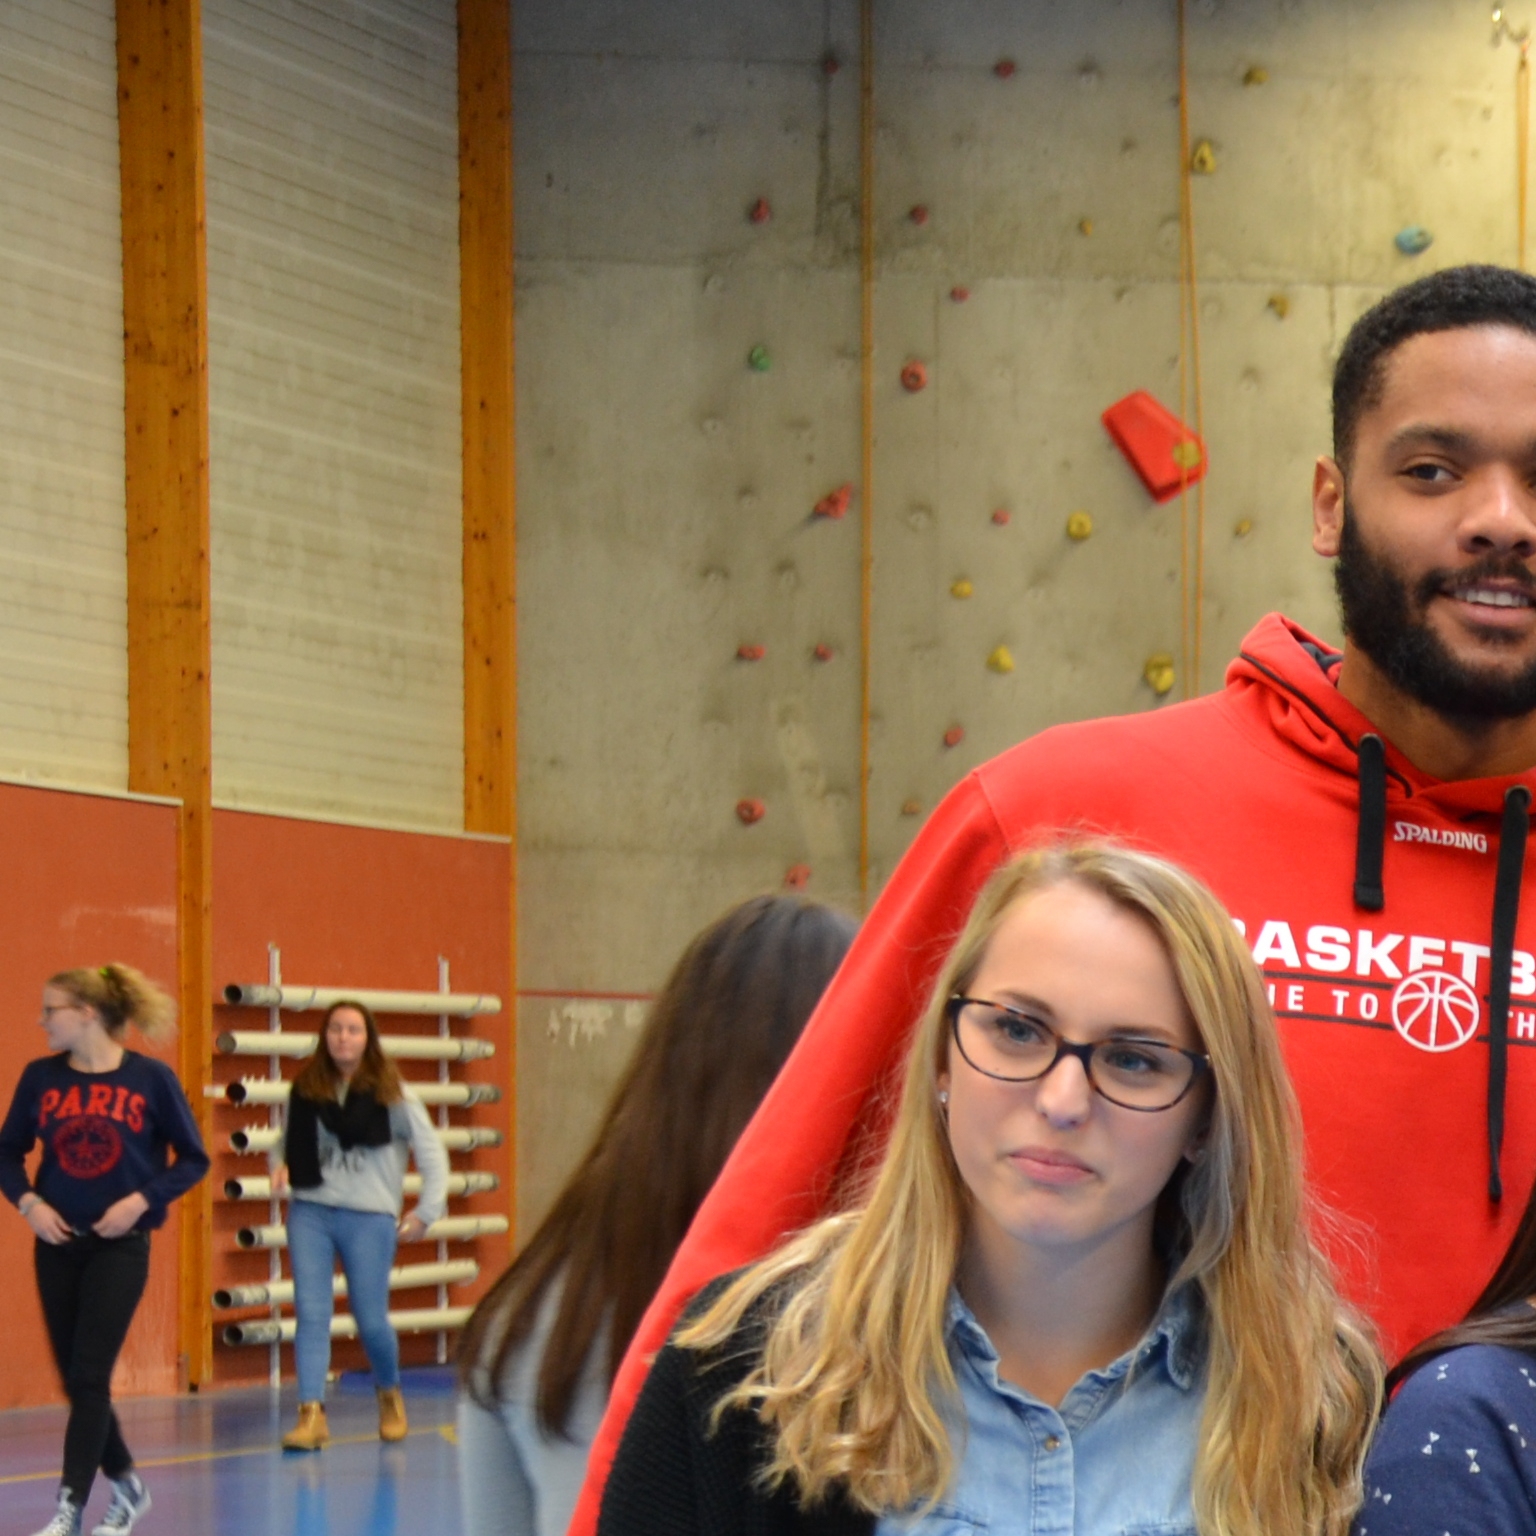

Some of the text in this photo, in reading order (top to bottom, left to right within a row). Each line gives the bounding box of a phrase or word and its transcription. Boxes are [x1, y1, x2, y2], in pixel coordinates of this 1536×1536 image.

[1393, 820, 1488, 854] SPALDING
[1331, 989, 1379, 1021] TO
[38, 1083, 147, 1134] PARIS
